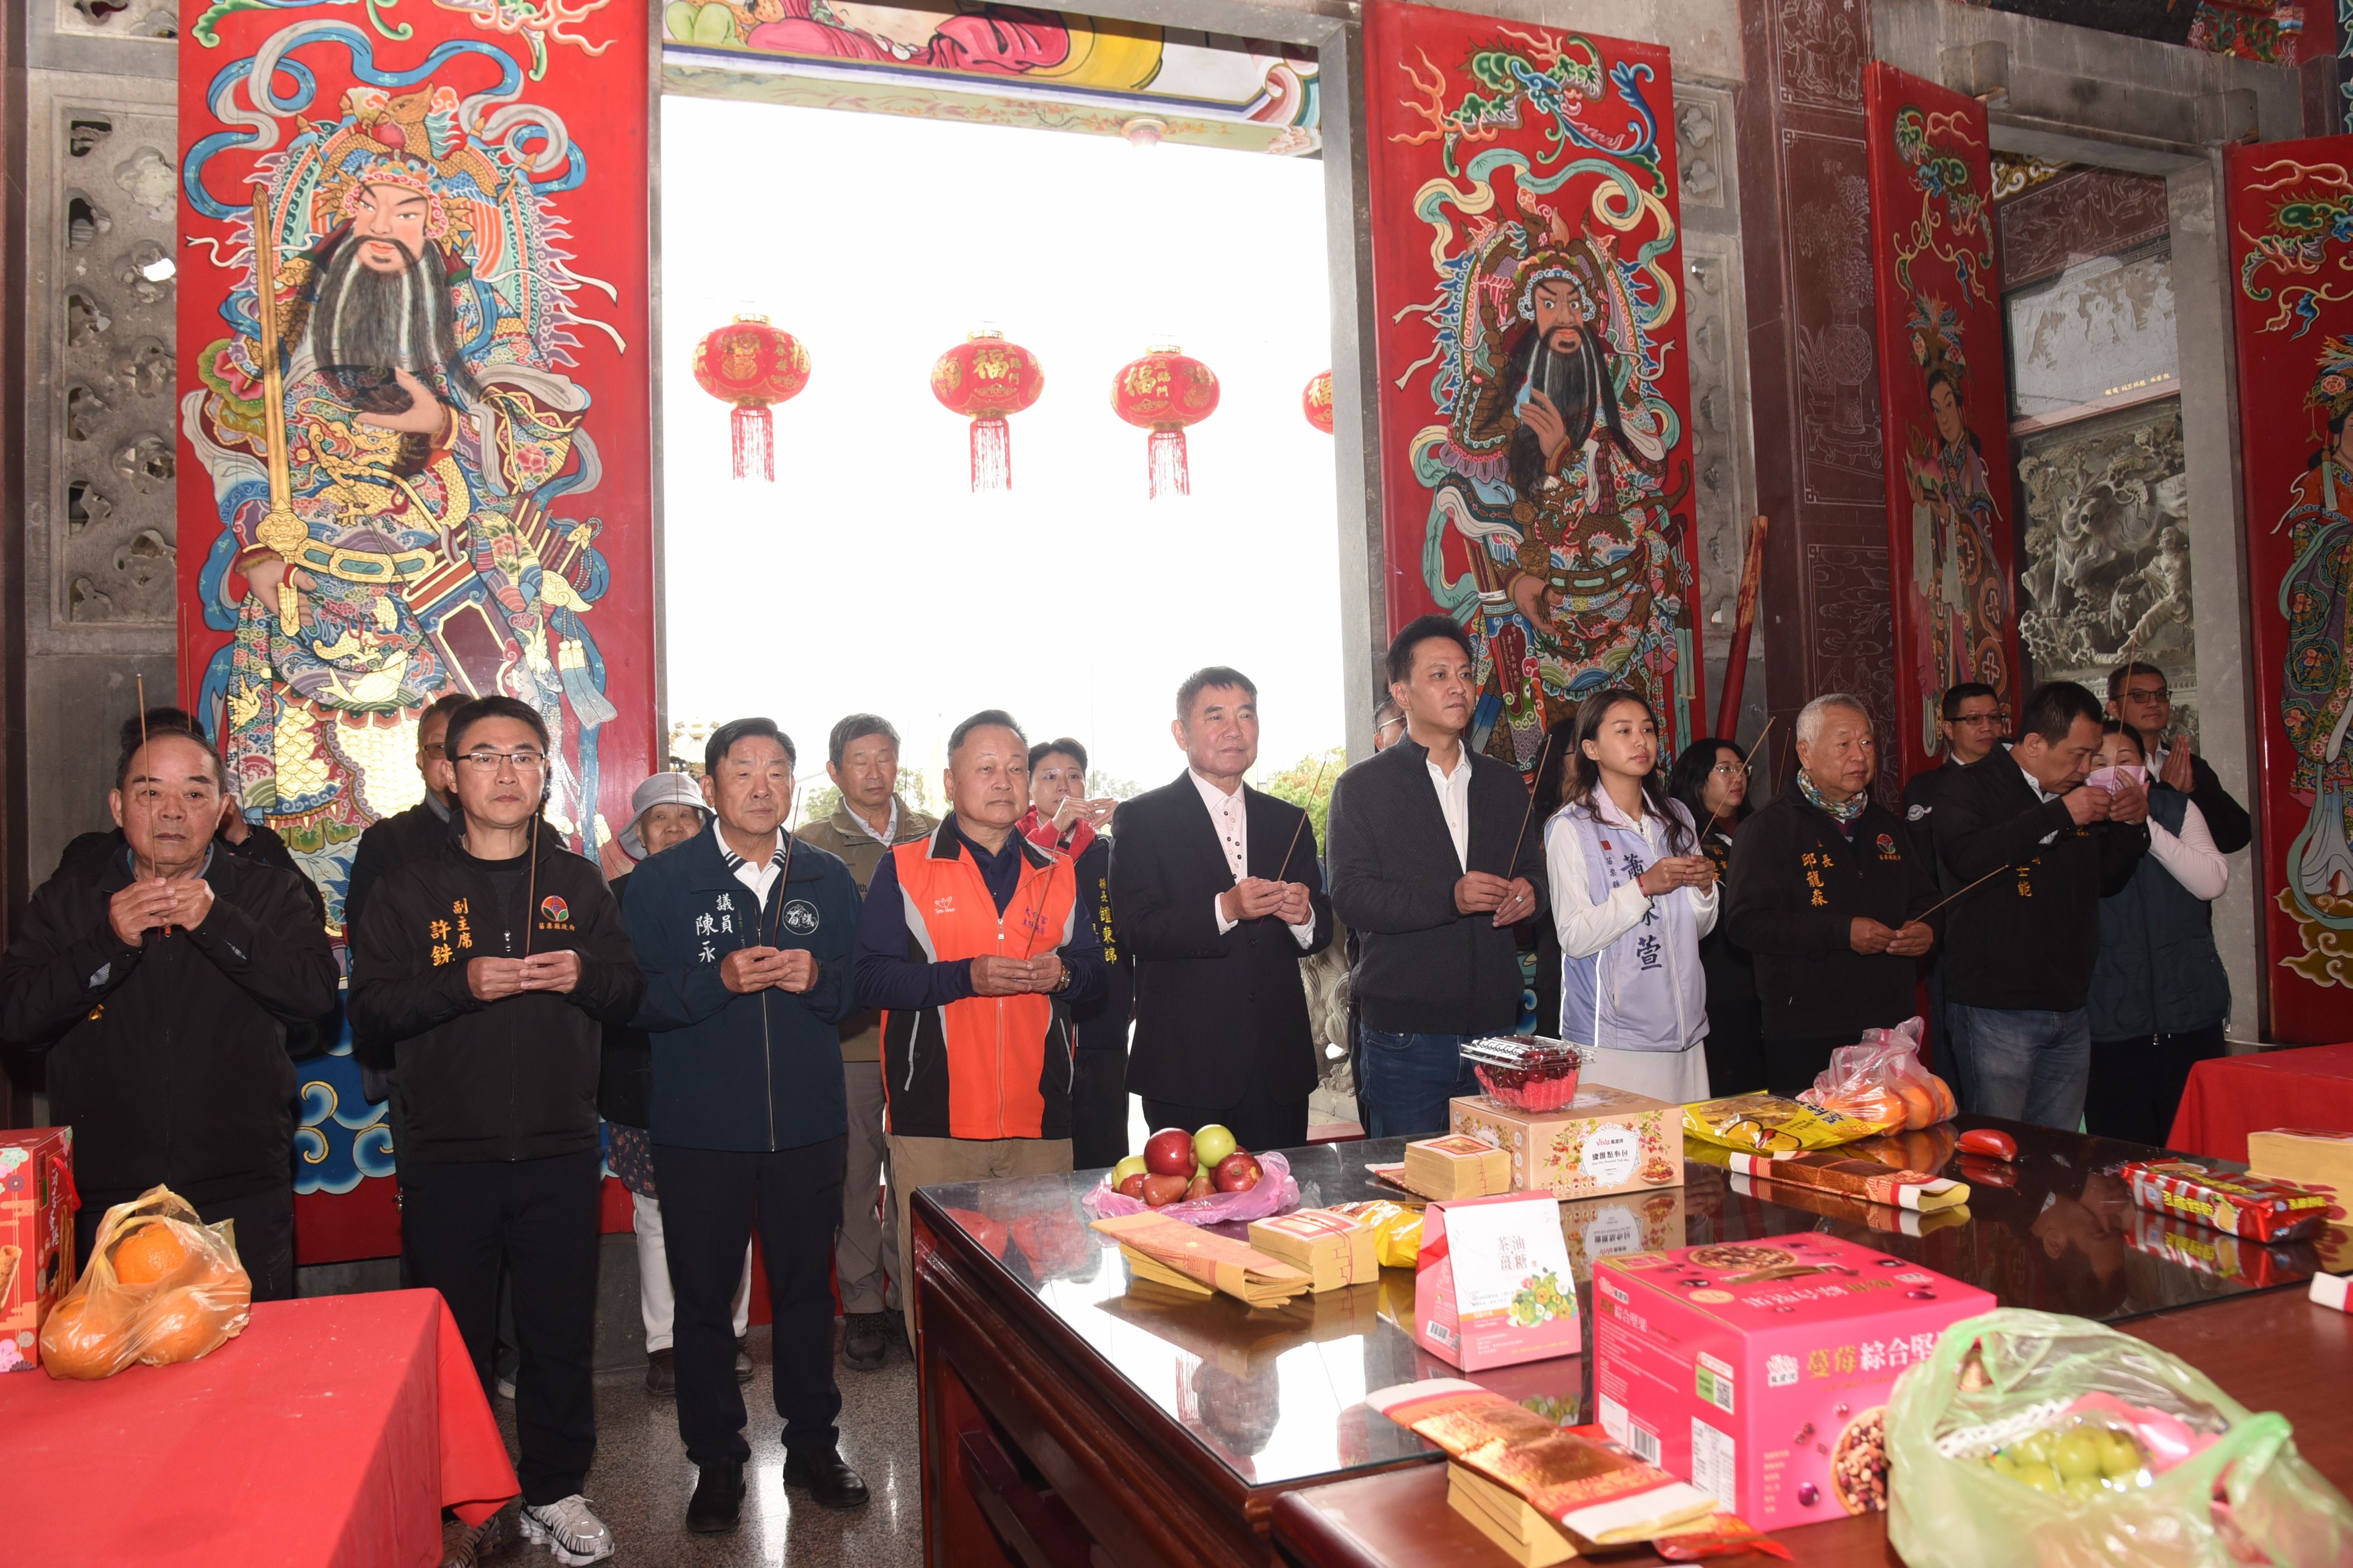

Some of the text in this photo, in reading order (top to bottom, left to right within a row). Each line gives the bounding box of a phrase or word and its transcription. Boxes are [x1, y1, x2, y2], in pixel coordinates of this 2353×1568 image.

[972, 348, 1009, 379] 福
[1123, 364, 1156, 397] 福
[1801, 852, 1829, 907] 邱龍森
[453, 897, 472, 949] 副主席
[716, 893, 735, 934] 議員
[695, 913, 719, 963] 陳永
[1497, 1234, 1525, 1252] 茶油
[1807, 1331, 1945, 1380] 蔓莓綜合堅
